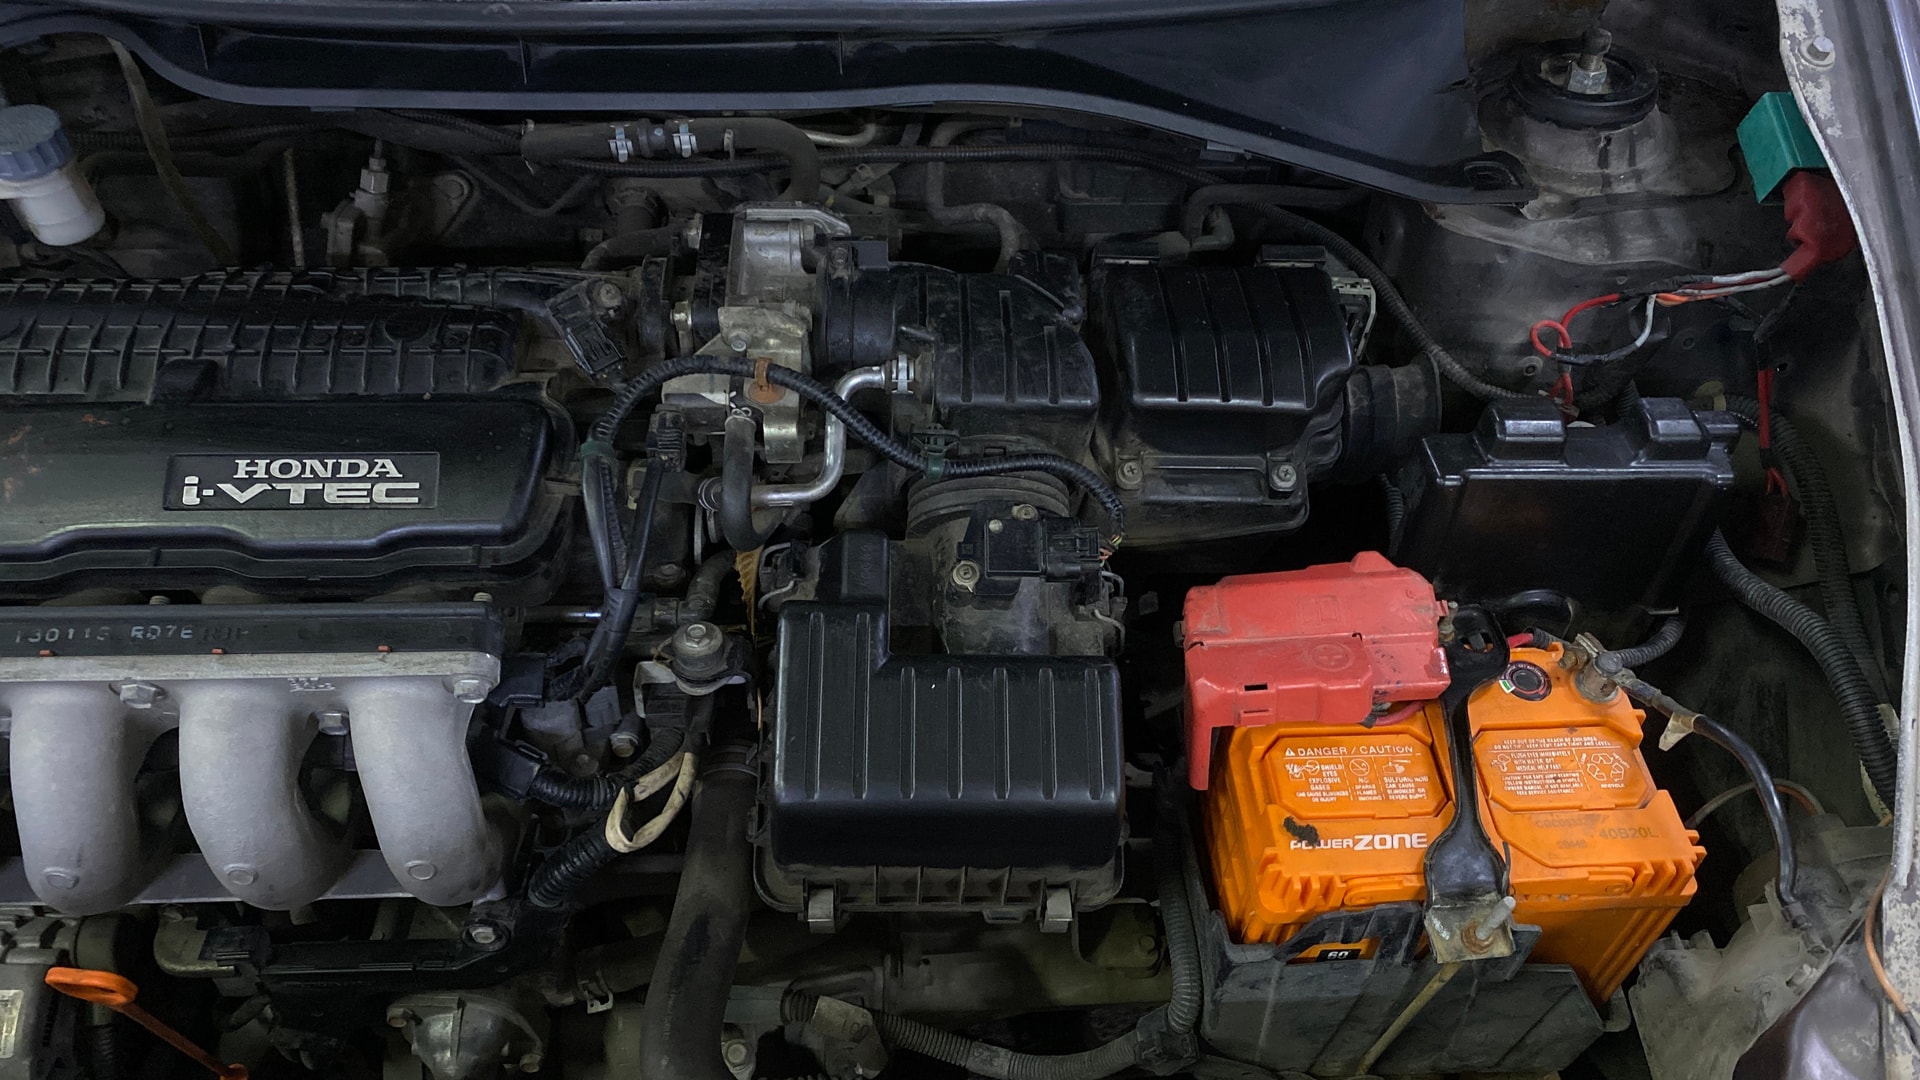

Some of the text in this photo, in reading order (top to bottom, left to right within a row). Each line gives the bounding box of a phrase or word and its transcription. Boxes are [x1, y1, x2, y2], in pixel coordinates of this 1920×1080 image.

[233, 458, 402, 478] HONDA
[182, 476, 420, 505] i-VTEC
[1297, 747, 1348, 756] DANGER
[1359, 745, 1413, 754] CAUTION
[1599, 826, 1659, 839] 40B20L
[1328, 950, 1348, 960] 60
